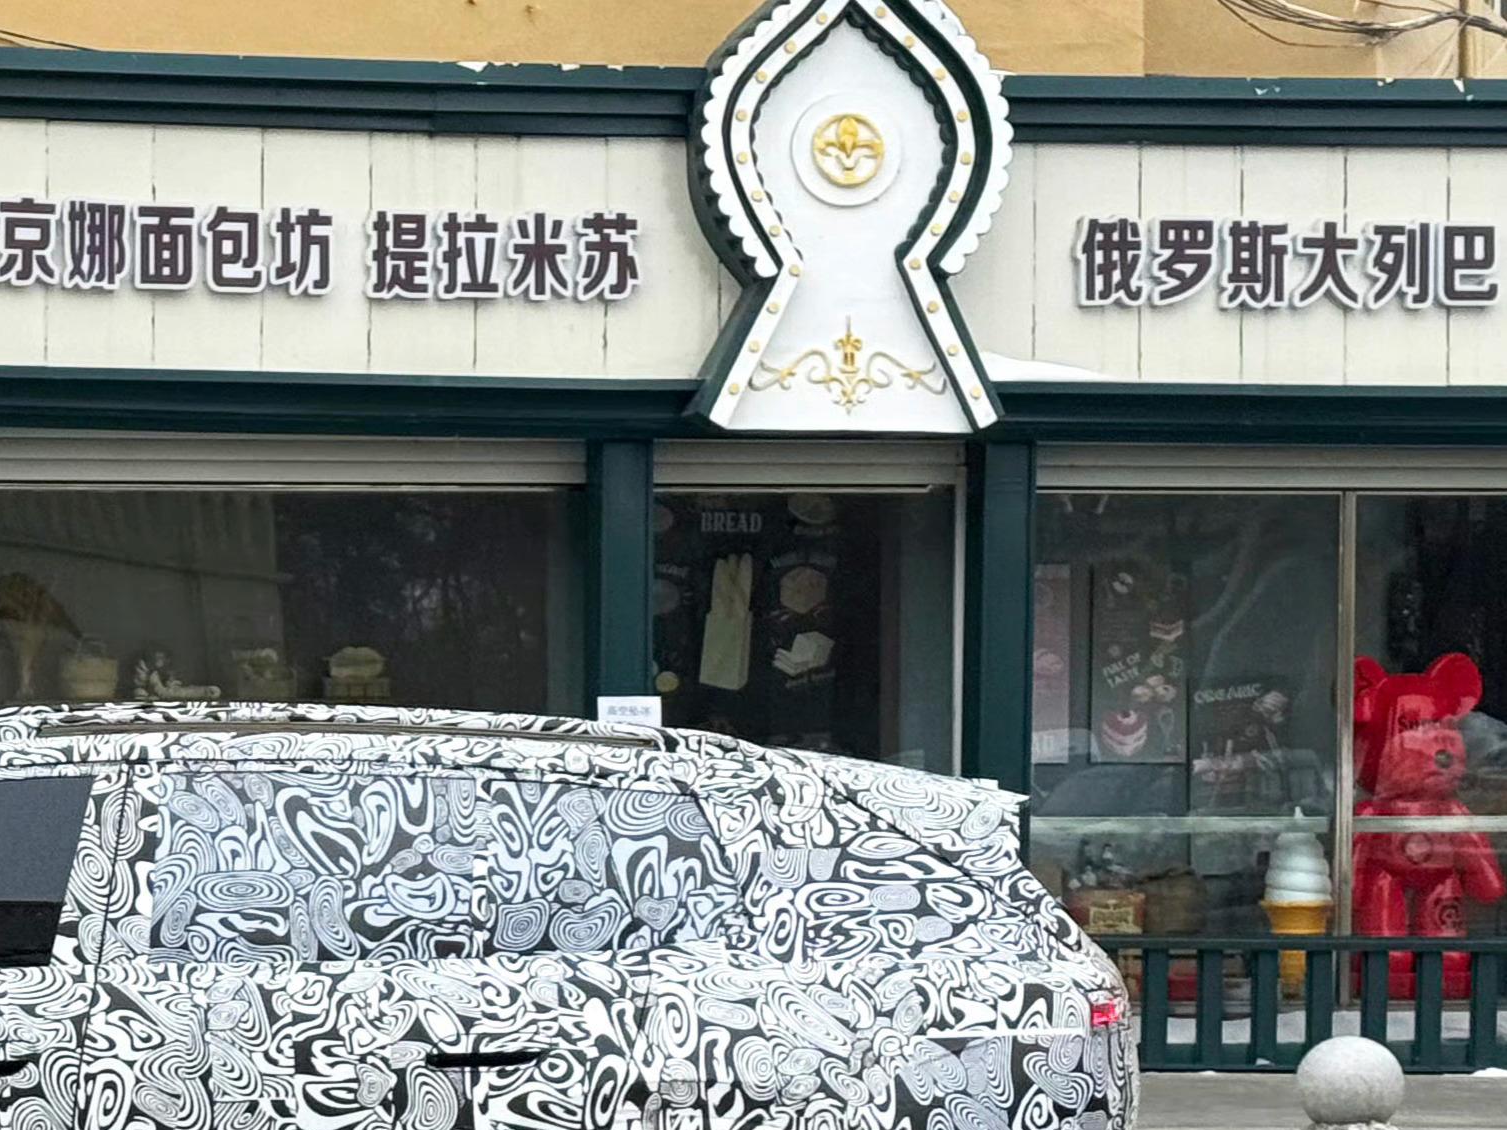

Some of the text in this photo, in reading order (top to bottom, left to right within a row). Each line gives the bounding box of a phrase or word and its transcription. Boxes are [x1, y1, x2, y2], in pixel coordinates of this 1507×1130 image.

[369, 210, 640, 297] 提拉米苏
[1081, 217, 1498, 303] 俄罗斯大列巴
[700, 511, 763, 533] BREAD
